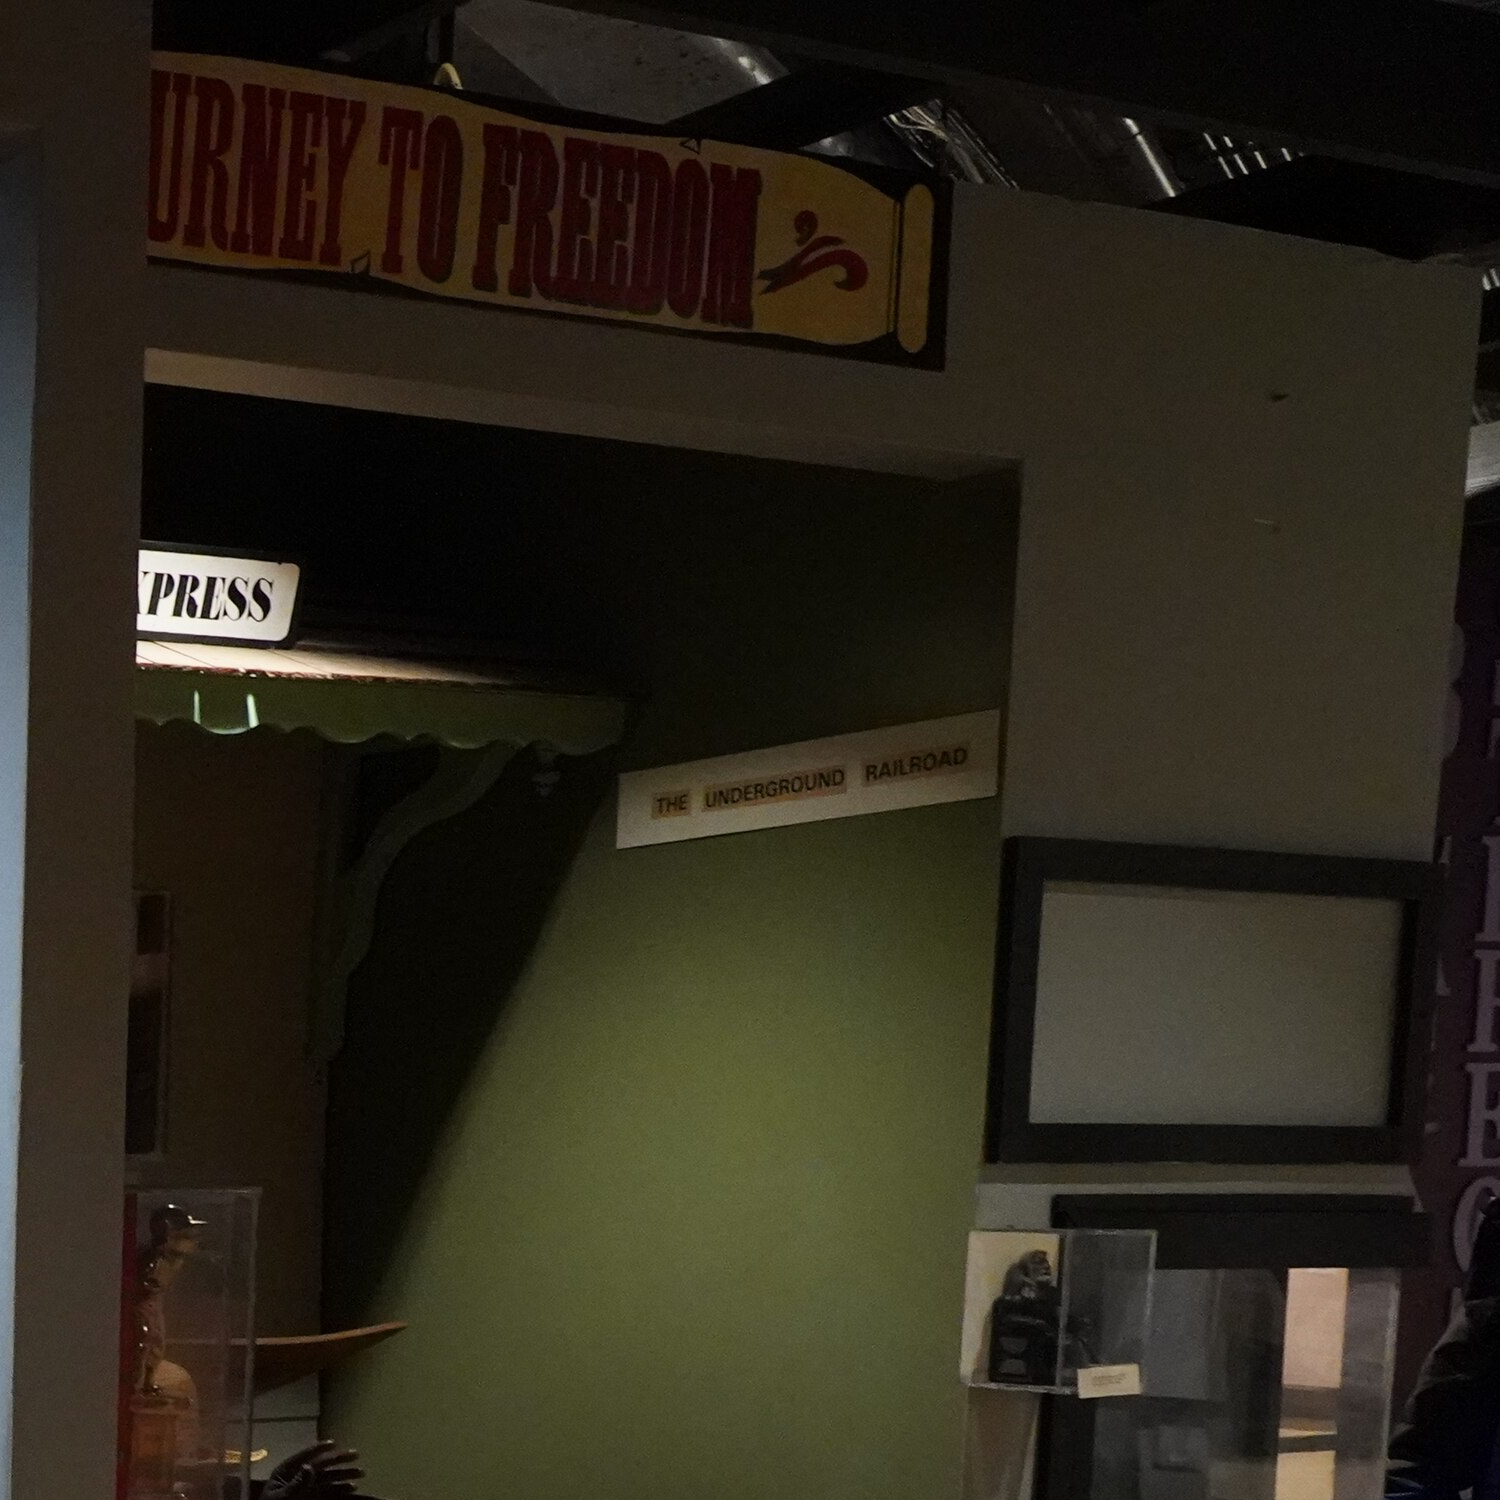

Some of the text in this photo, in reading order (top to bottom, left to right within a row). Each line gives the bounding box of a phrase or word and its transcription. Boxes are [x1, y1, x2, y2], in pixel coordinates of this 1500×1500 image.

[379, 105, 463, 283] TO
[472, 123, 763, 329] FREEDOM
[137, 570, 274, 623] PRESS
[656, 747, 968, 815] THE UNDERGROUND RAILROAD
